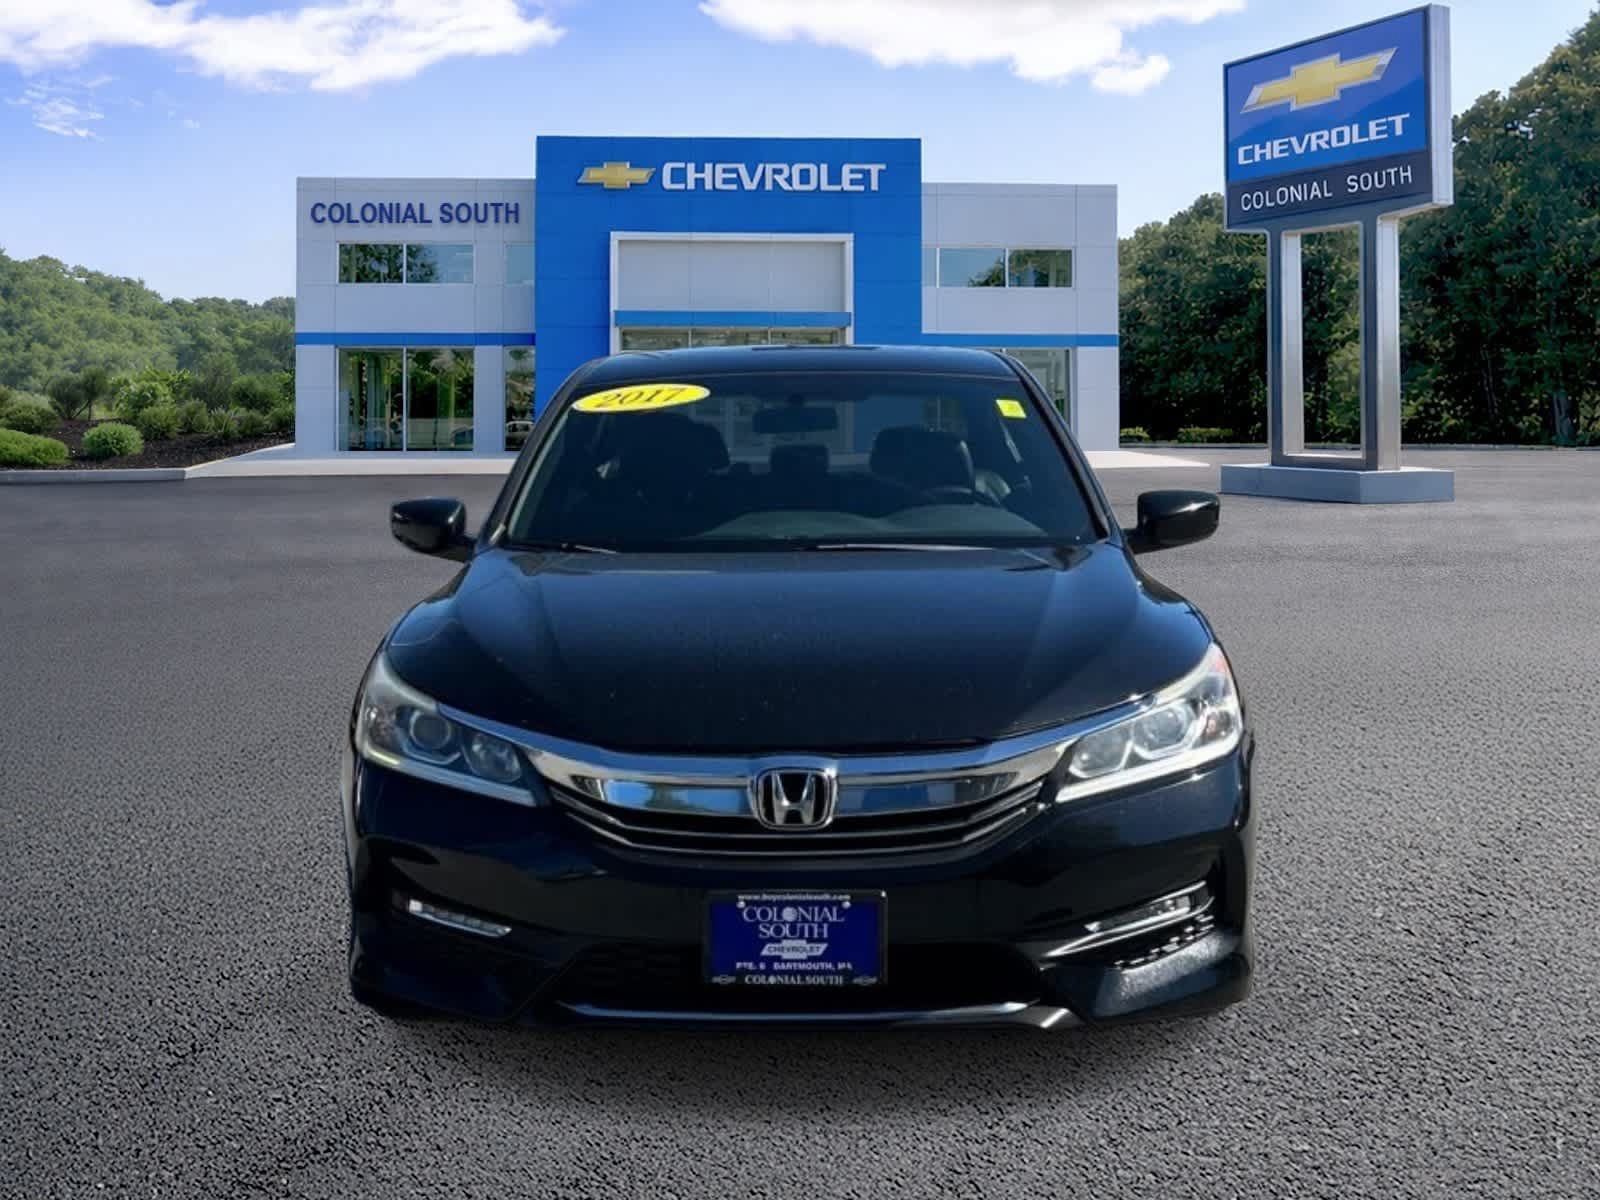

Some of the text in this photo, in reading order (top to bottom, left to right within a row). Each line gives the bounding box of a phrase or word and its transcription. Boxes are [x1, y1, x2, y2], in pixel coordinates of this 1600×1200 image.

[1237, 112, 1410, 165] CHEVROLET
[661, 161, 887, 191] CHEVROLET
[1240, 164, 1413, 212] COLONIAL SOUTH
[310, 202, 520, 224] COLONIAL SOUTH
[593, 386, 688, 409] 2017
[742, 906, 845, 922] COLONIAL
[758, 922, 829, 939] SOUTH
[744, 974, 843, 985] COLONIAL SOUTH
